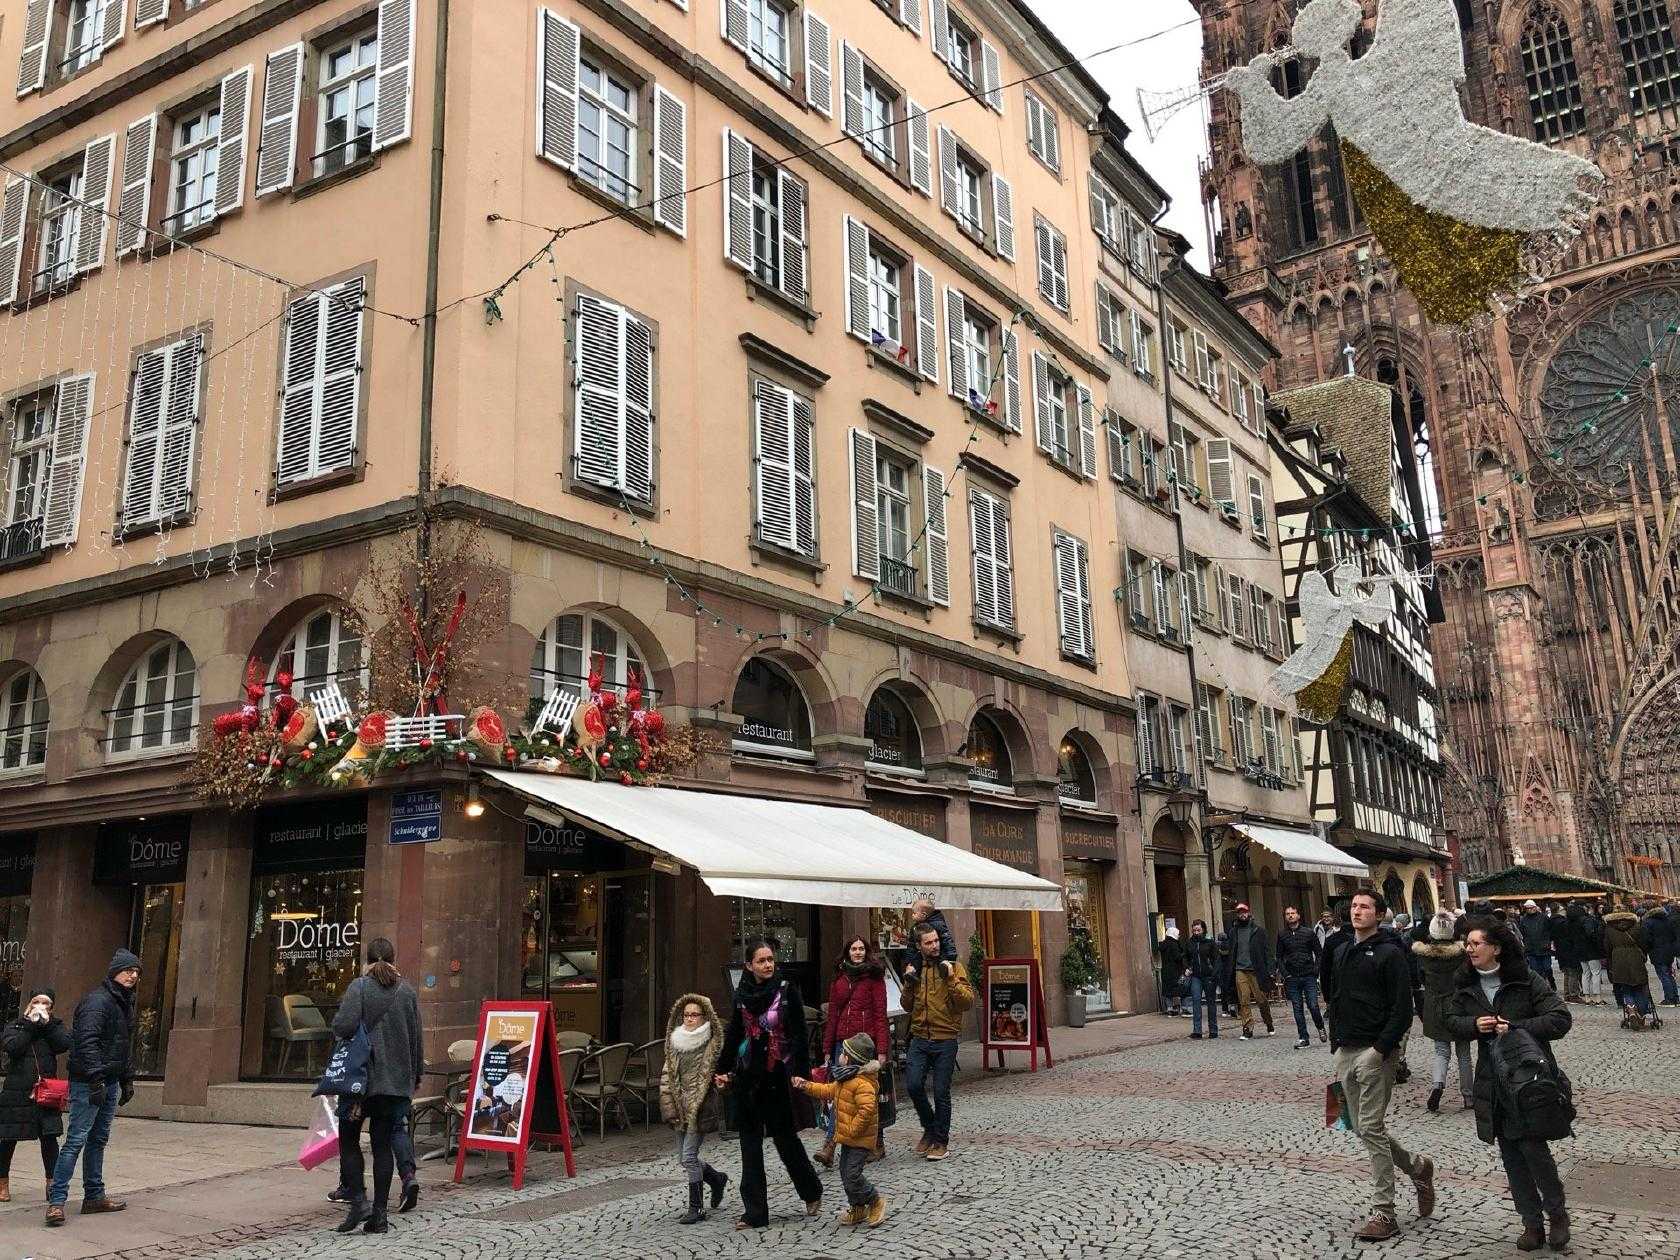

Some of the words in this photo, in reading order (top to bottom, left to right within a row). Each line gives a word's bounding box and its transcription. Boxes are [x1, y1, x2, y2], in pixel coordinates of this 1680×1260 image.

[737, 722, 793, 742] restaurant
[130, 838, 182, 861] Dôme
[277, 916, 359, 949] Dôme
